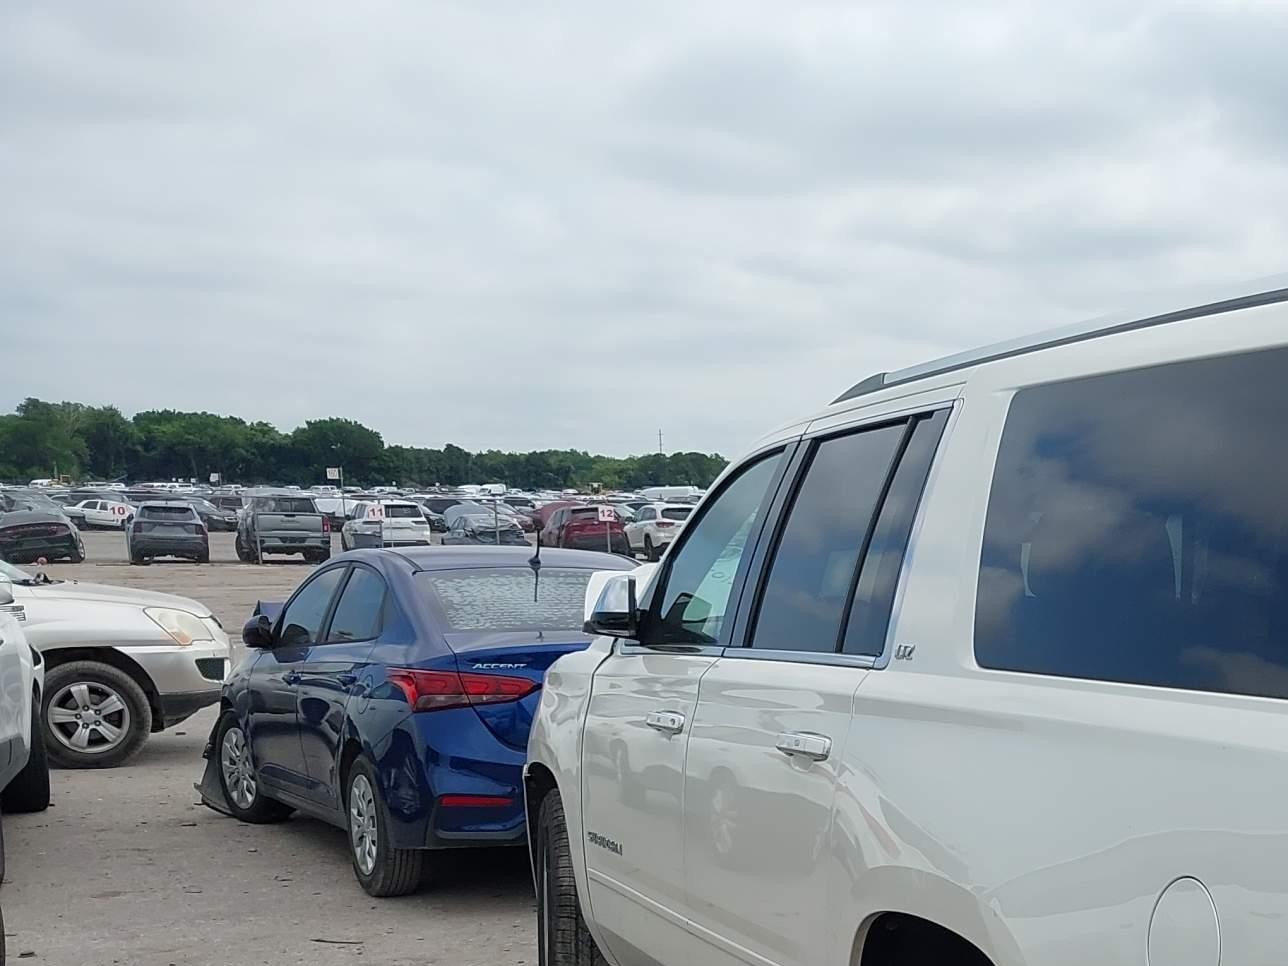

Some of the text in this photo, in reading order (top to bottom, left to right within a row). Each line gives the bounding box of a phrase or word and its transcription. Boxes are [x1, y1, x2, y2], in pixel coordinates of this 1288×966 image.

[110, 506, 126, 515] 10
[369, 508, 383, 517] 11
[600, 509, 613, 518] 12
